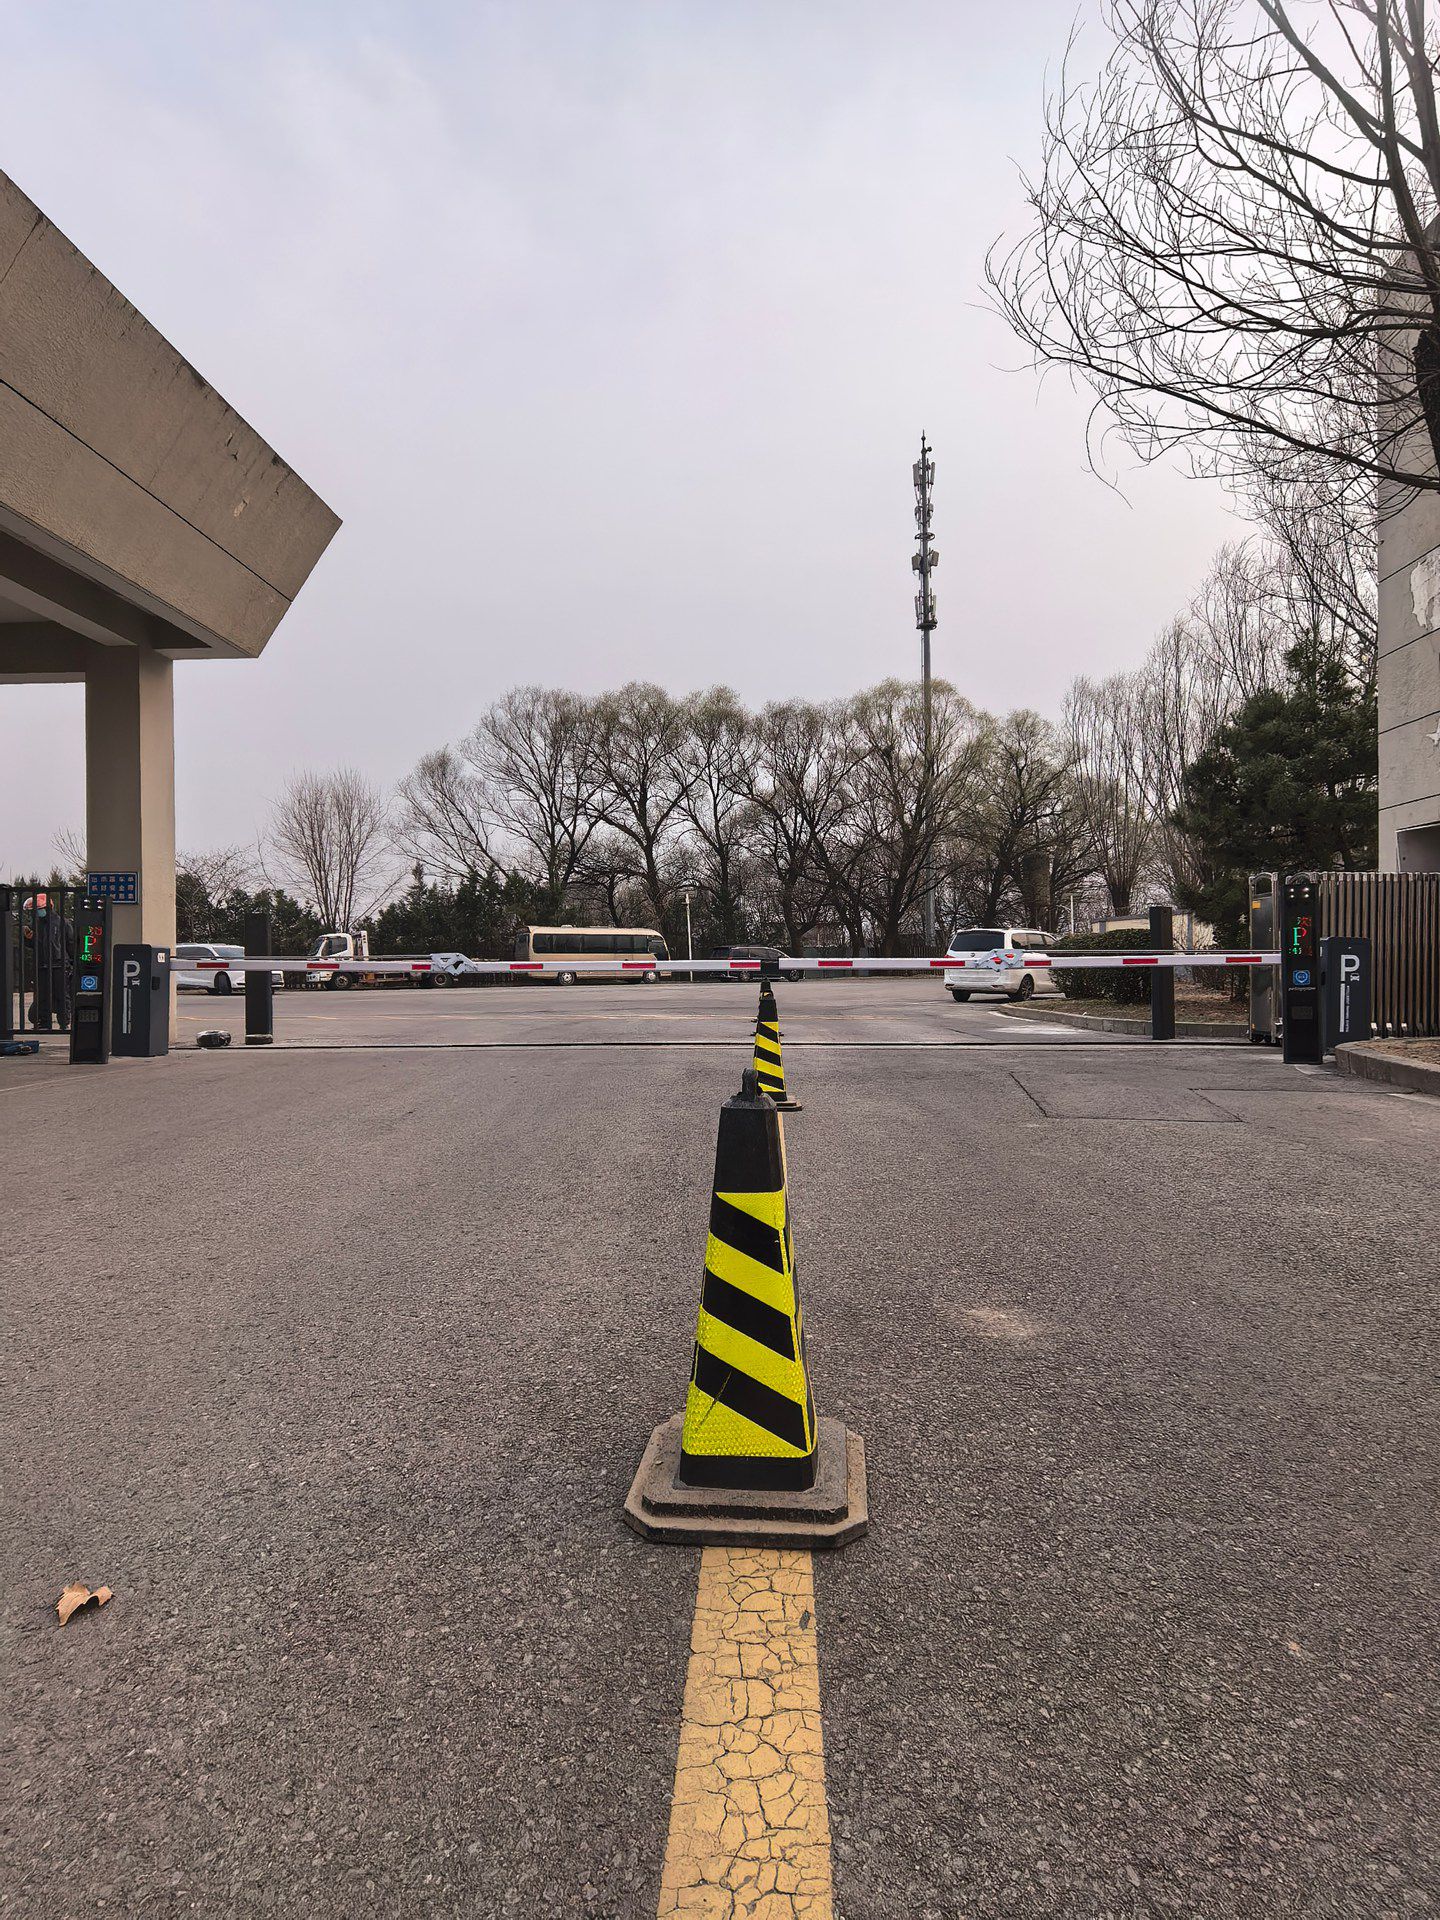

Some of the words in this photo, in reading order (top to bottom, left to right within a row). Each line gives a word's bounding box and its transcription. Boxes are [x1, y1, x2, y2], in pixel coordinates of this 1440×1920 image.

[84, 935, 97, 953] P
[1293, 927, 1308, 945] P
[123, 960, 141, 986] P
[1340, 954, 1360, 982] P
